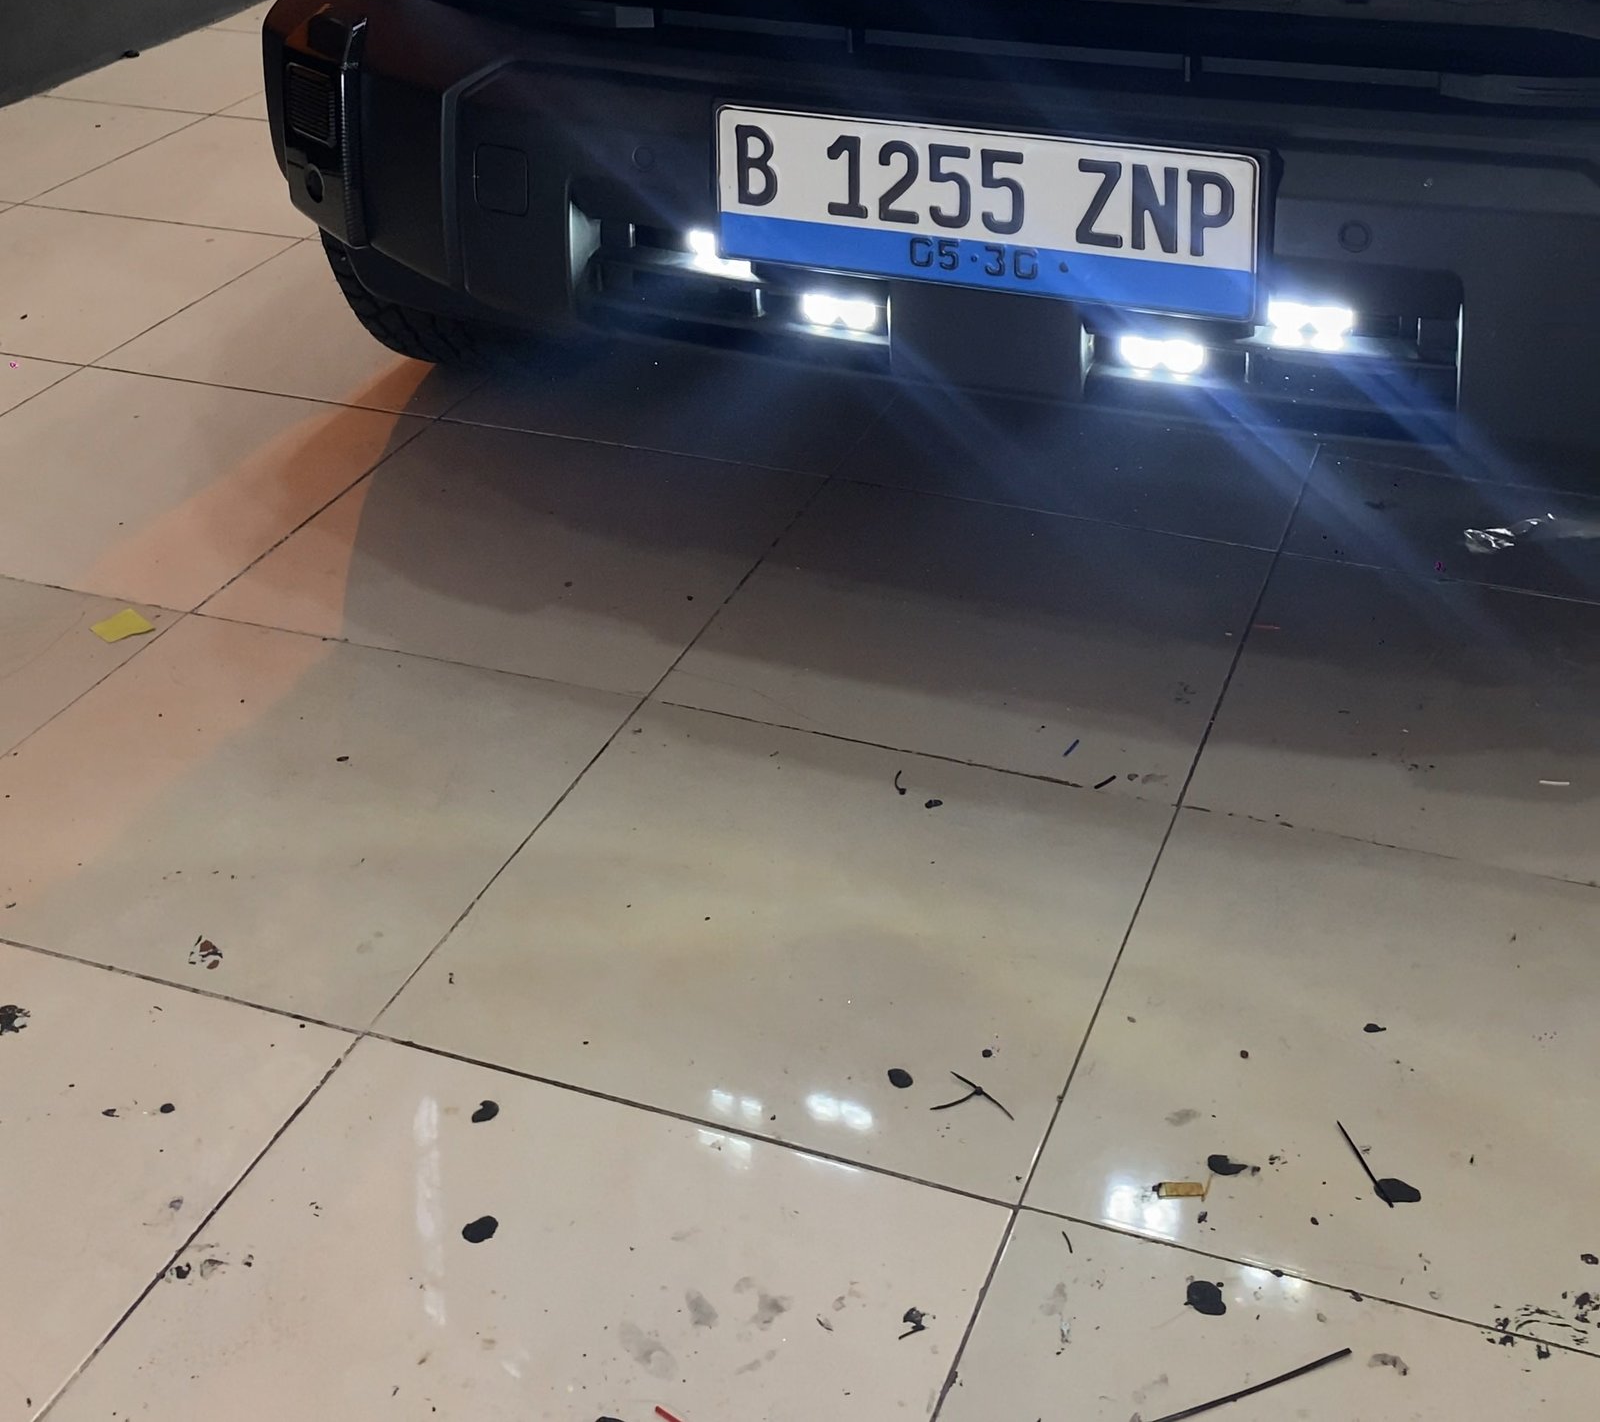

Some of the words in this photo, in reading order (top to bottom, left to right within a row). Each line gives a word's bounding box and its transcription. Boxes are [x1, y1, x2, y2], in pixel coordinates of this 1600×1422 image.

[735, 124, 779, 207] B
[826, 134, 1024, 235] 1255
[1074, 157, 1236, 258] ZNP
